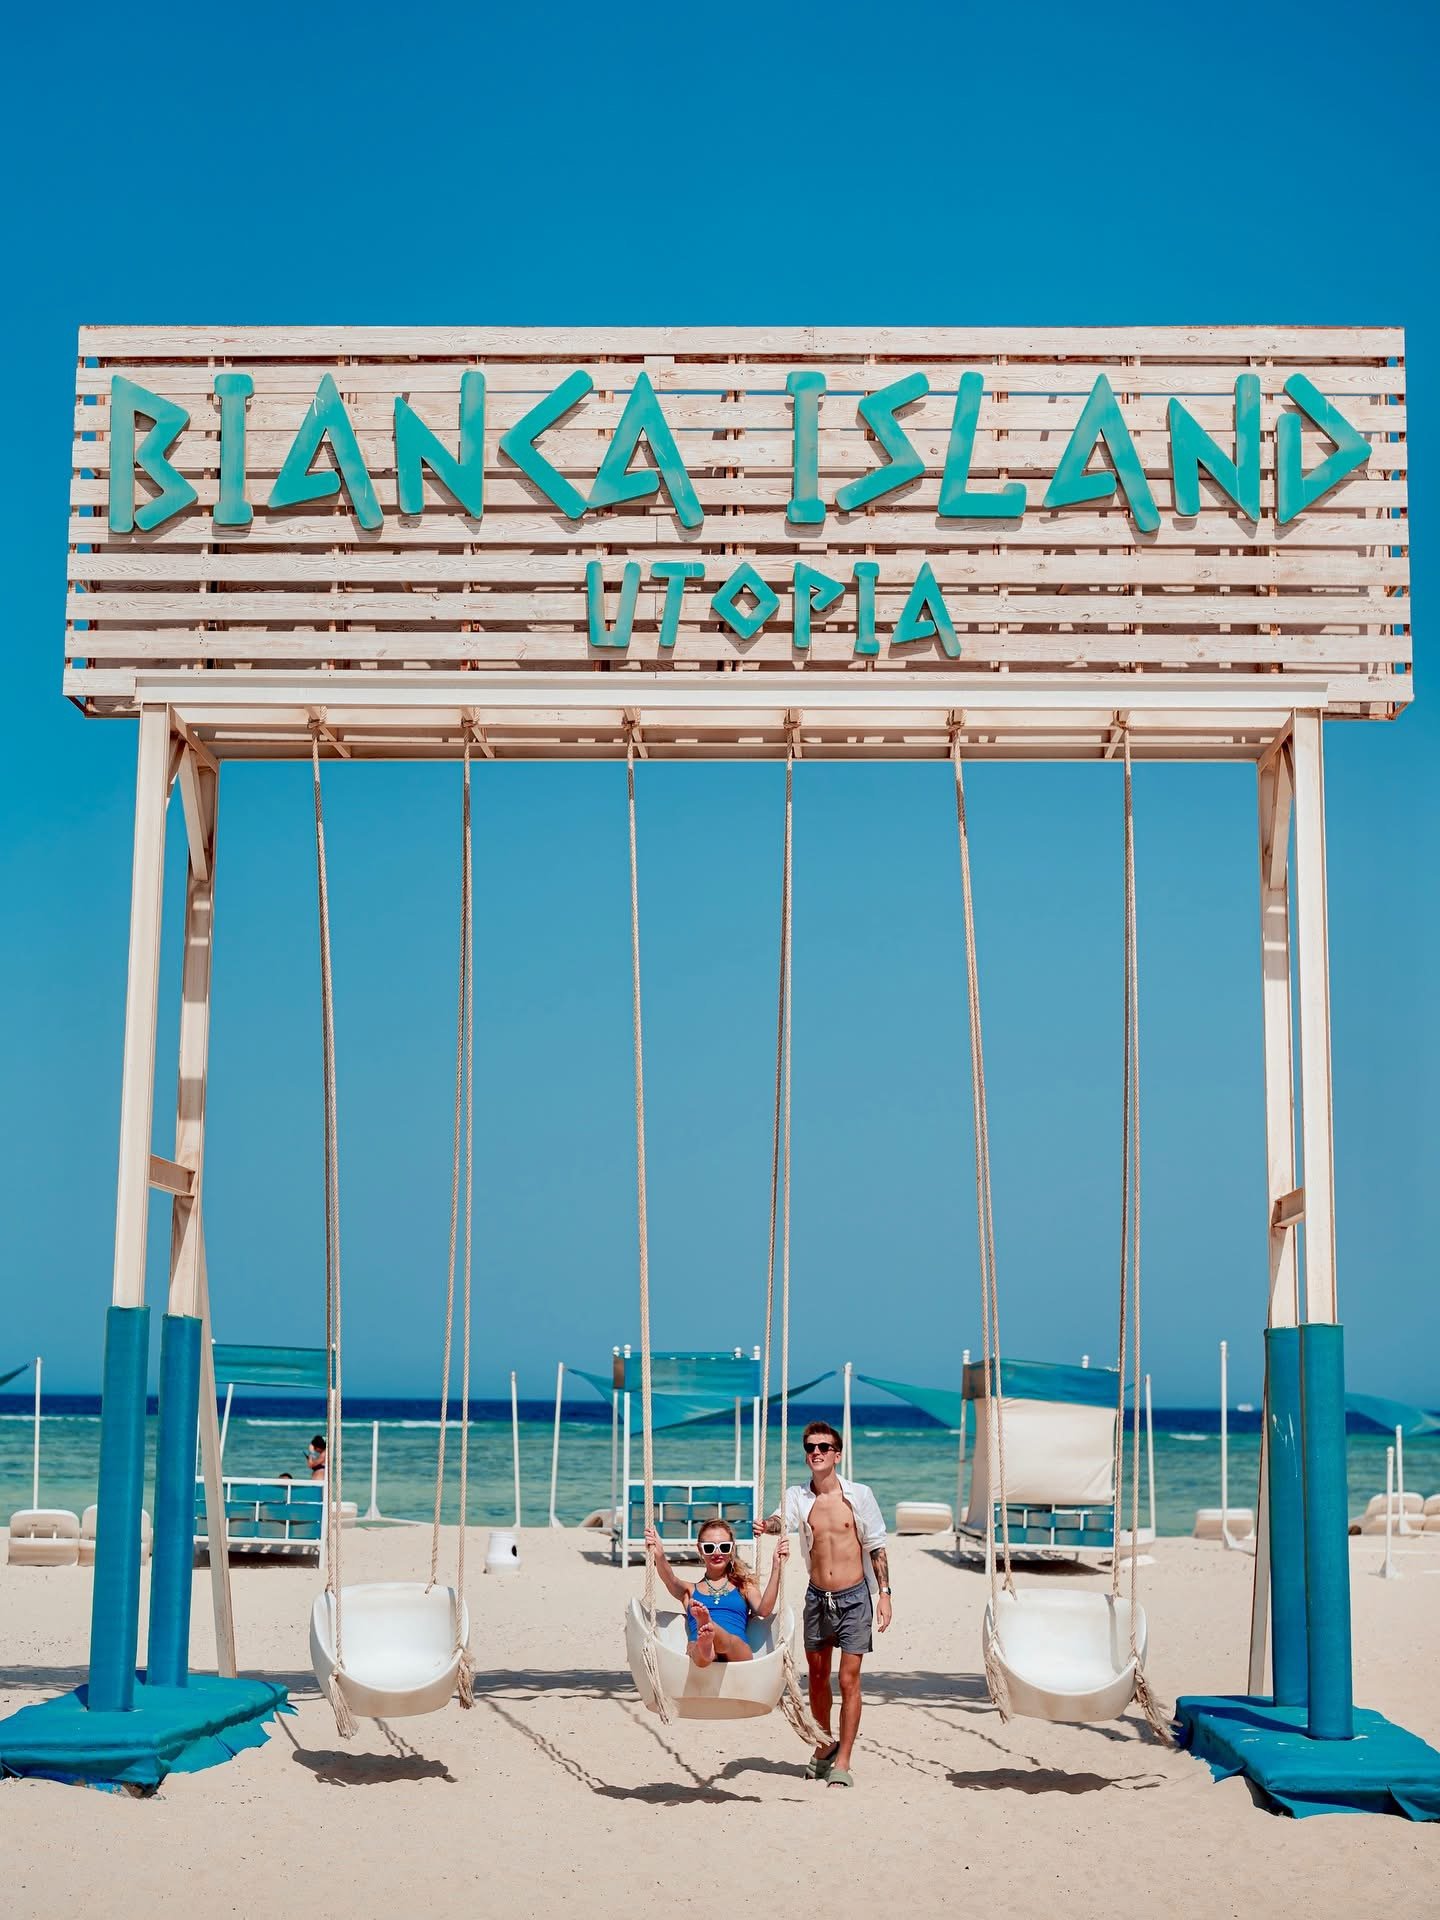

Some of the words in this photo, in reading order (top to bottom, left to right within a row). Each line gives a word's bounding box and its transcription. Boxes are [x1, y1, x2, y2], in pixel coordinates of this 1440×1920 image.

[109, 369, 704, 533] BIANCA
[786, 371, 1372, 533] ISLAND
[586, 561, 962, 658] UTOPIA
